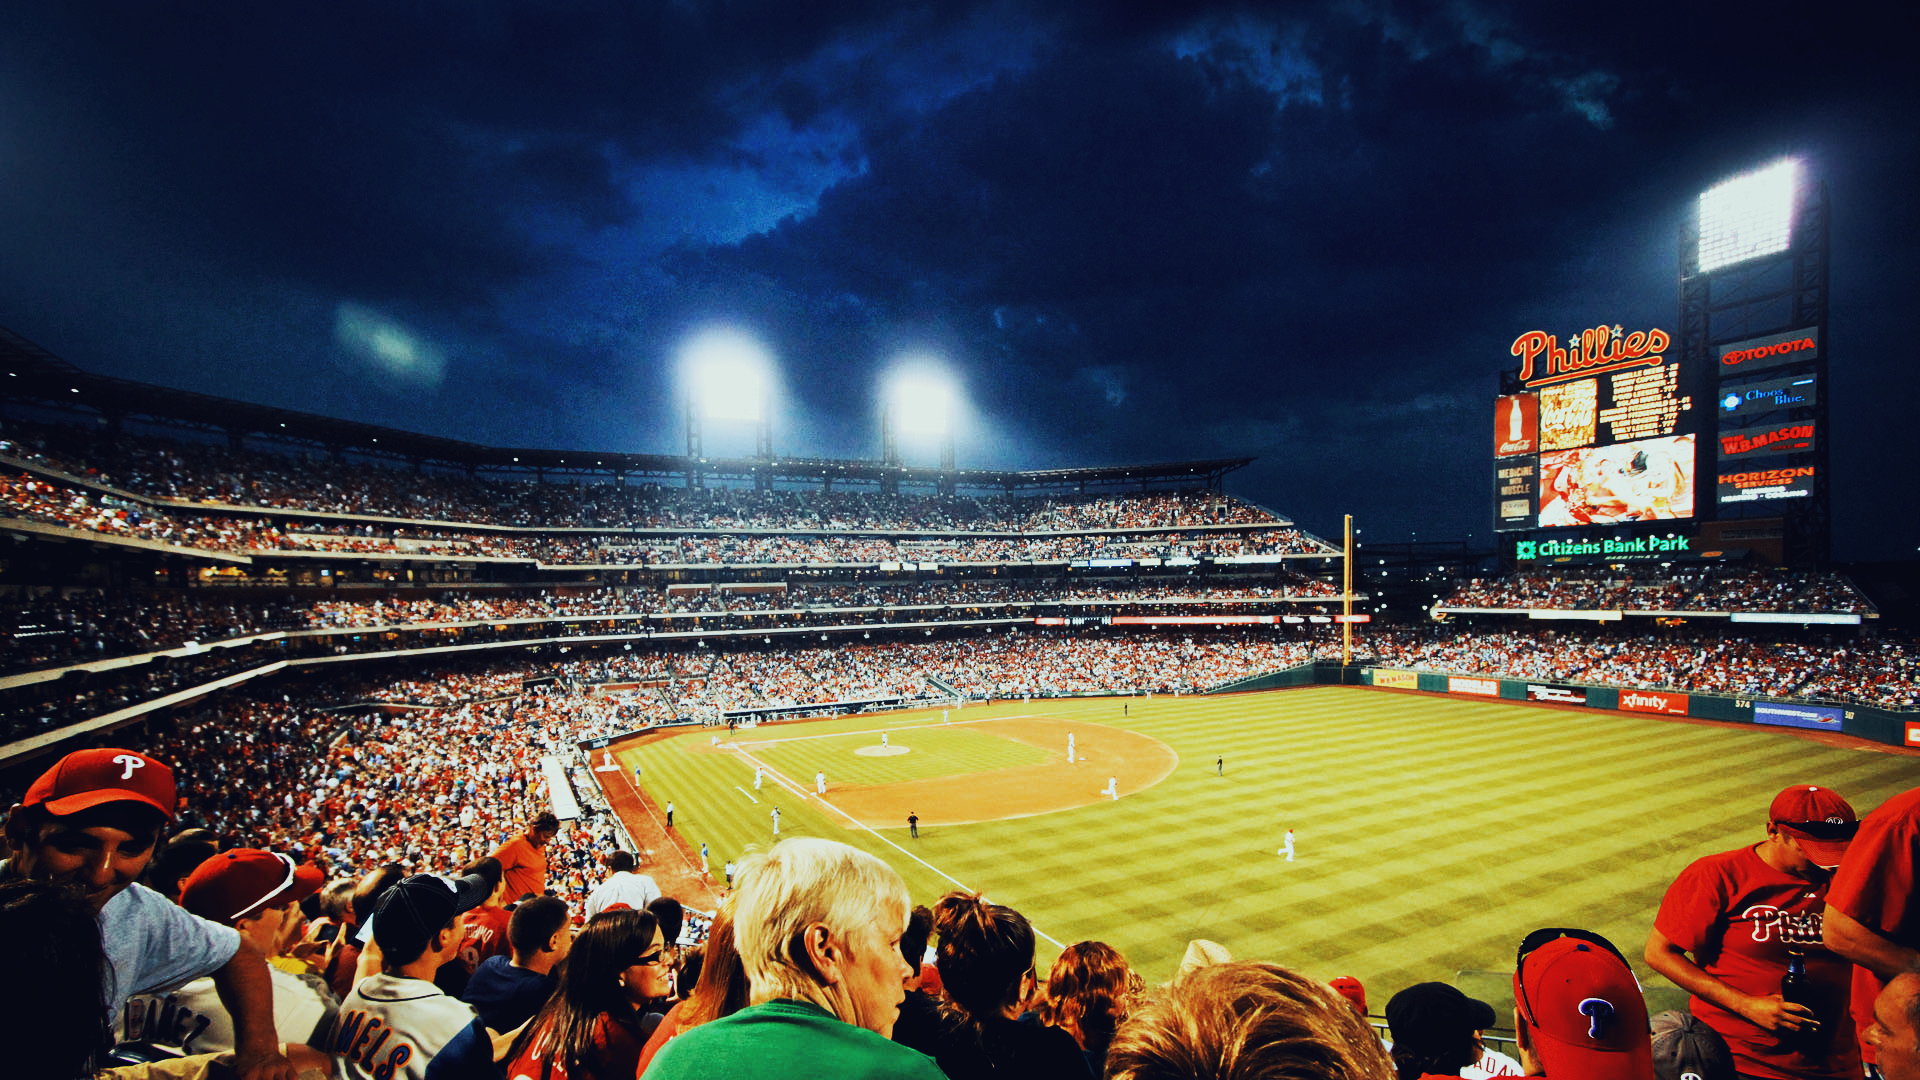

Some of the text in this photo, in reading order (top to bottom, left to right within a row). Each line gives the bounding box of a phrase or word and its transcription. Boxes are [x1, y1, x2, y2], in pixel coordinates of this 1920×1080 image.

[1511, 324, 1671, 380] Phillies
[1744, 338, 1815, 360] TOYOTA
[1498, 466, 1534, 479] MEDICINE
[1718, 466, 1815, 485] HORIZON
[1501, 483, 1531, 496] MUSCLE
[1734, 478, 1794, 489] SERVICES
[1539, 535, 1690, 557] Citizens Bank Park
[1622, 694, 1667, 710] xfinity
[112, 754, 146, 780] P
[1578, 997, 1615, 1039] P
